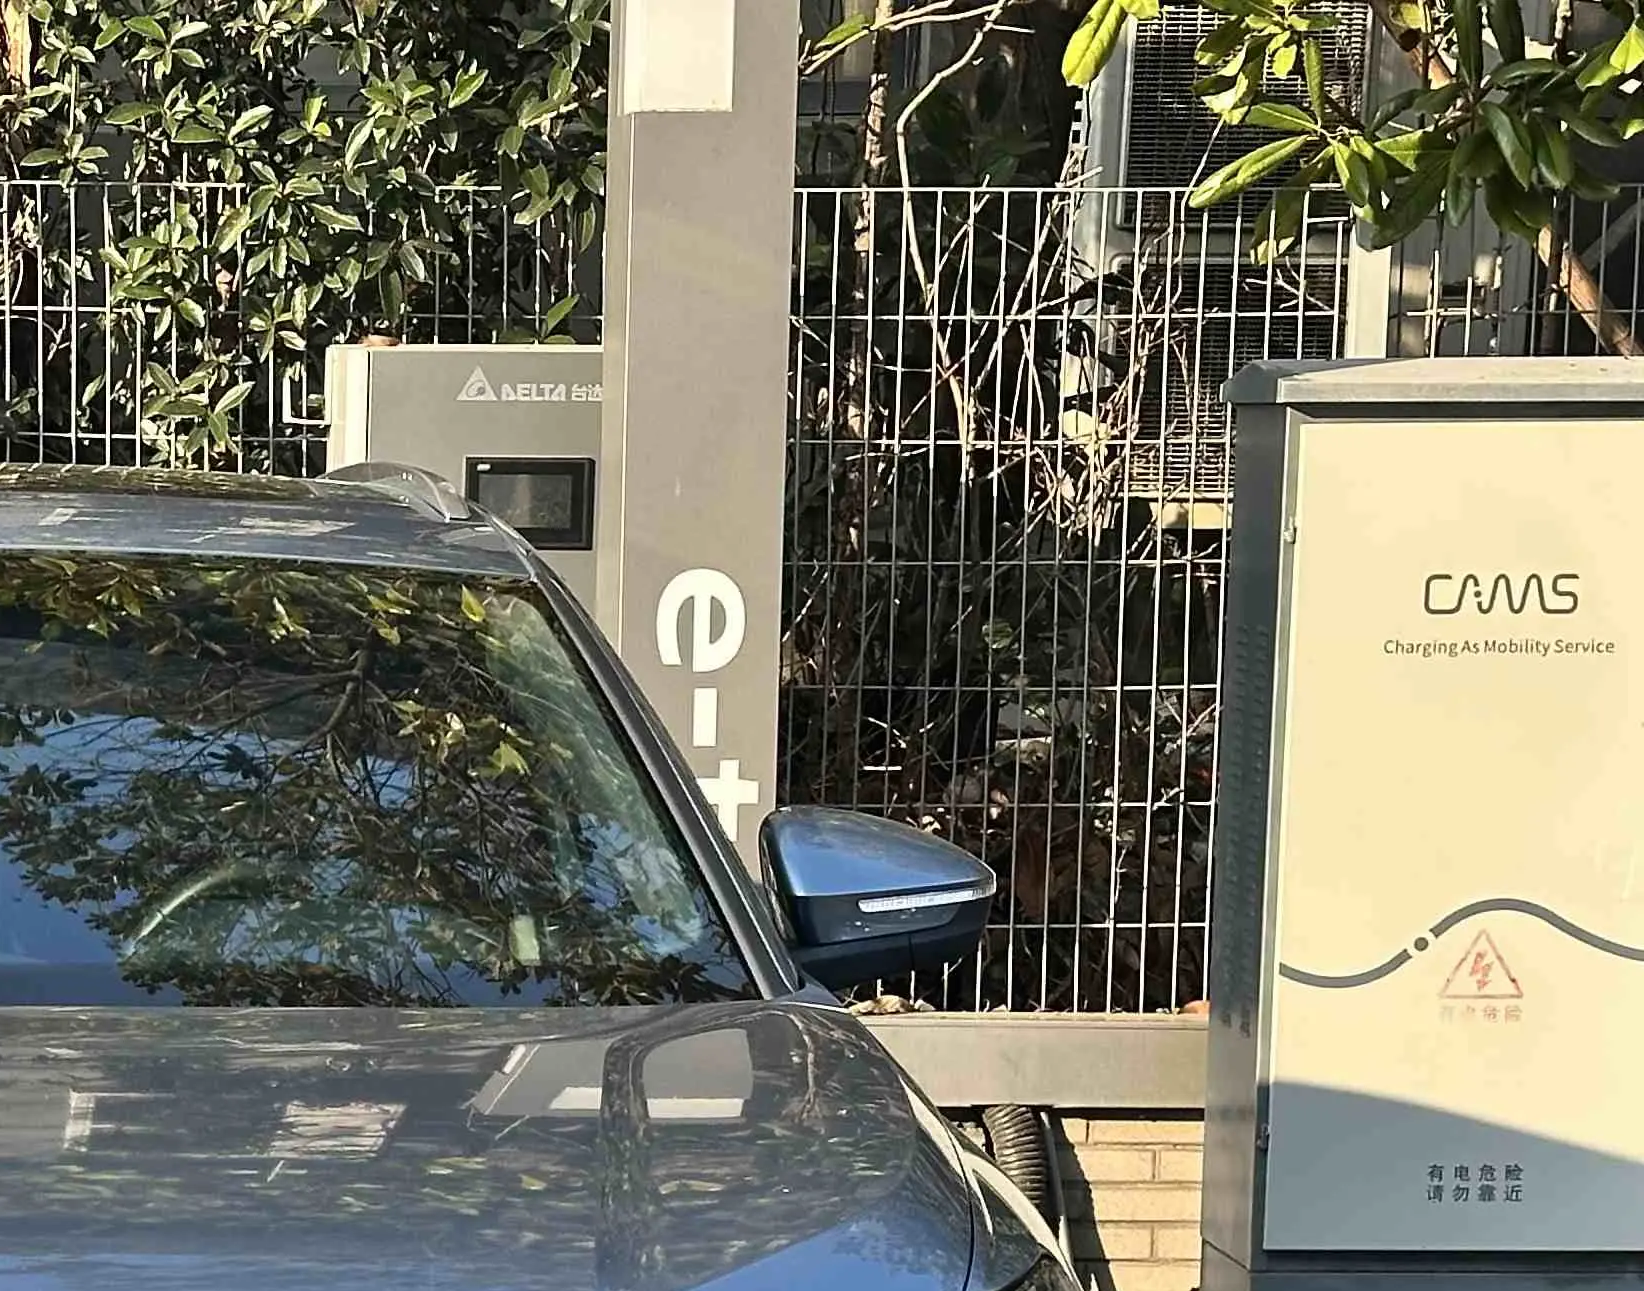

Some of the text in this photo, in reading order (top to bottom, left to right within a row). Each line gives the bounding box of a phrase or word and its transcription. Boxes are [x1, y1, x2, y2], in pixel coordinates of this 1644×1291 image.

[501, 382, 567, 402] DELTA
[1423, 572, 1581, 615] CAMS
[1383, 638, 1616, 658] Charging As Mobility Service
[1426, 1163, 1525, 1183] 有电危险
[1426, 1183, 1524, 1203] 请勿靠近
